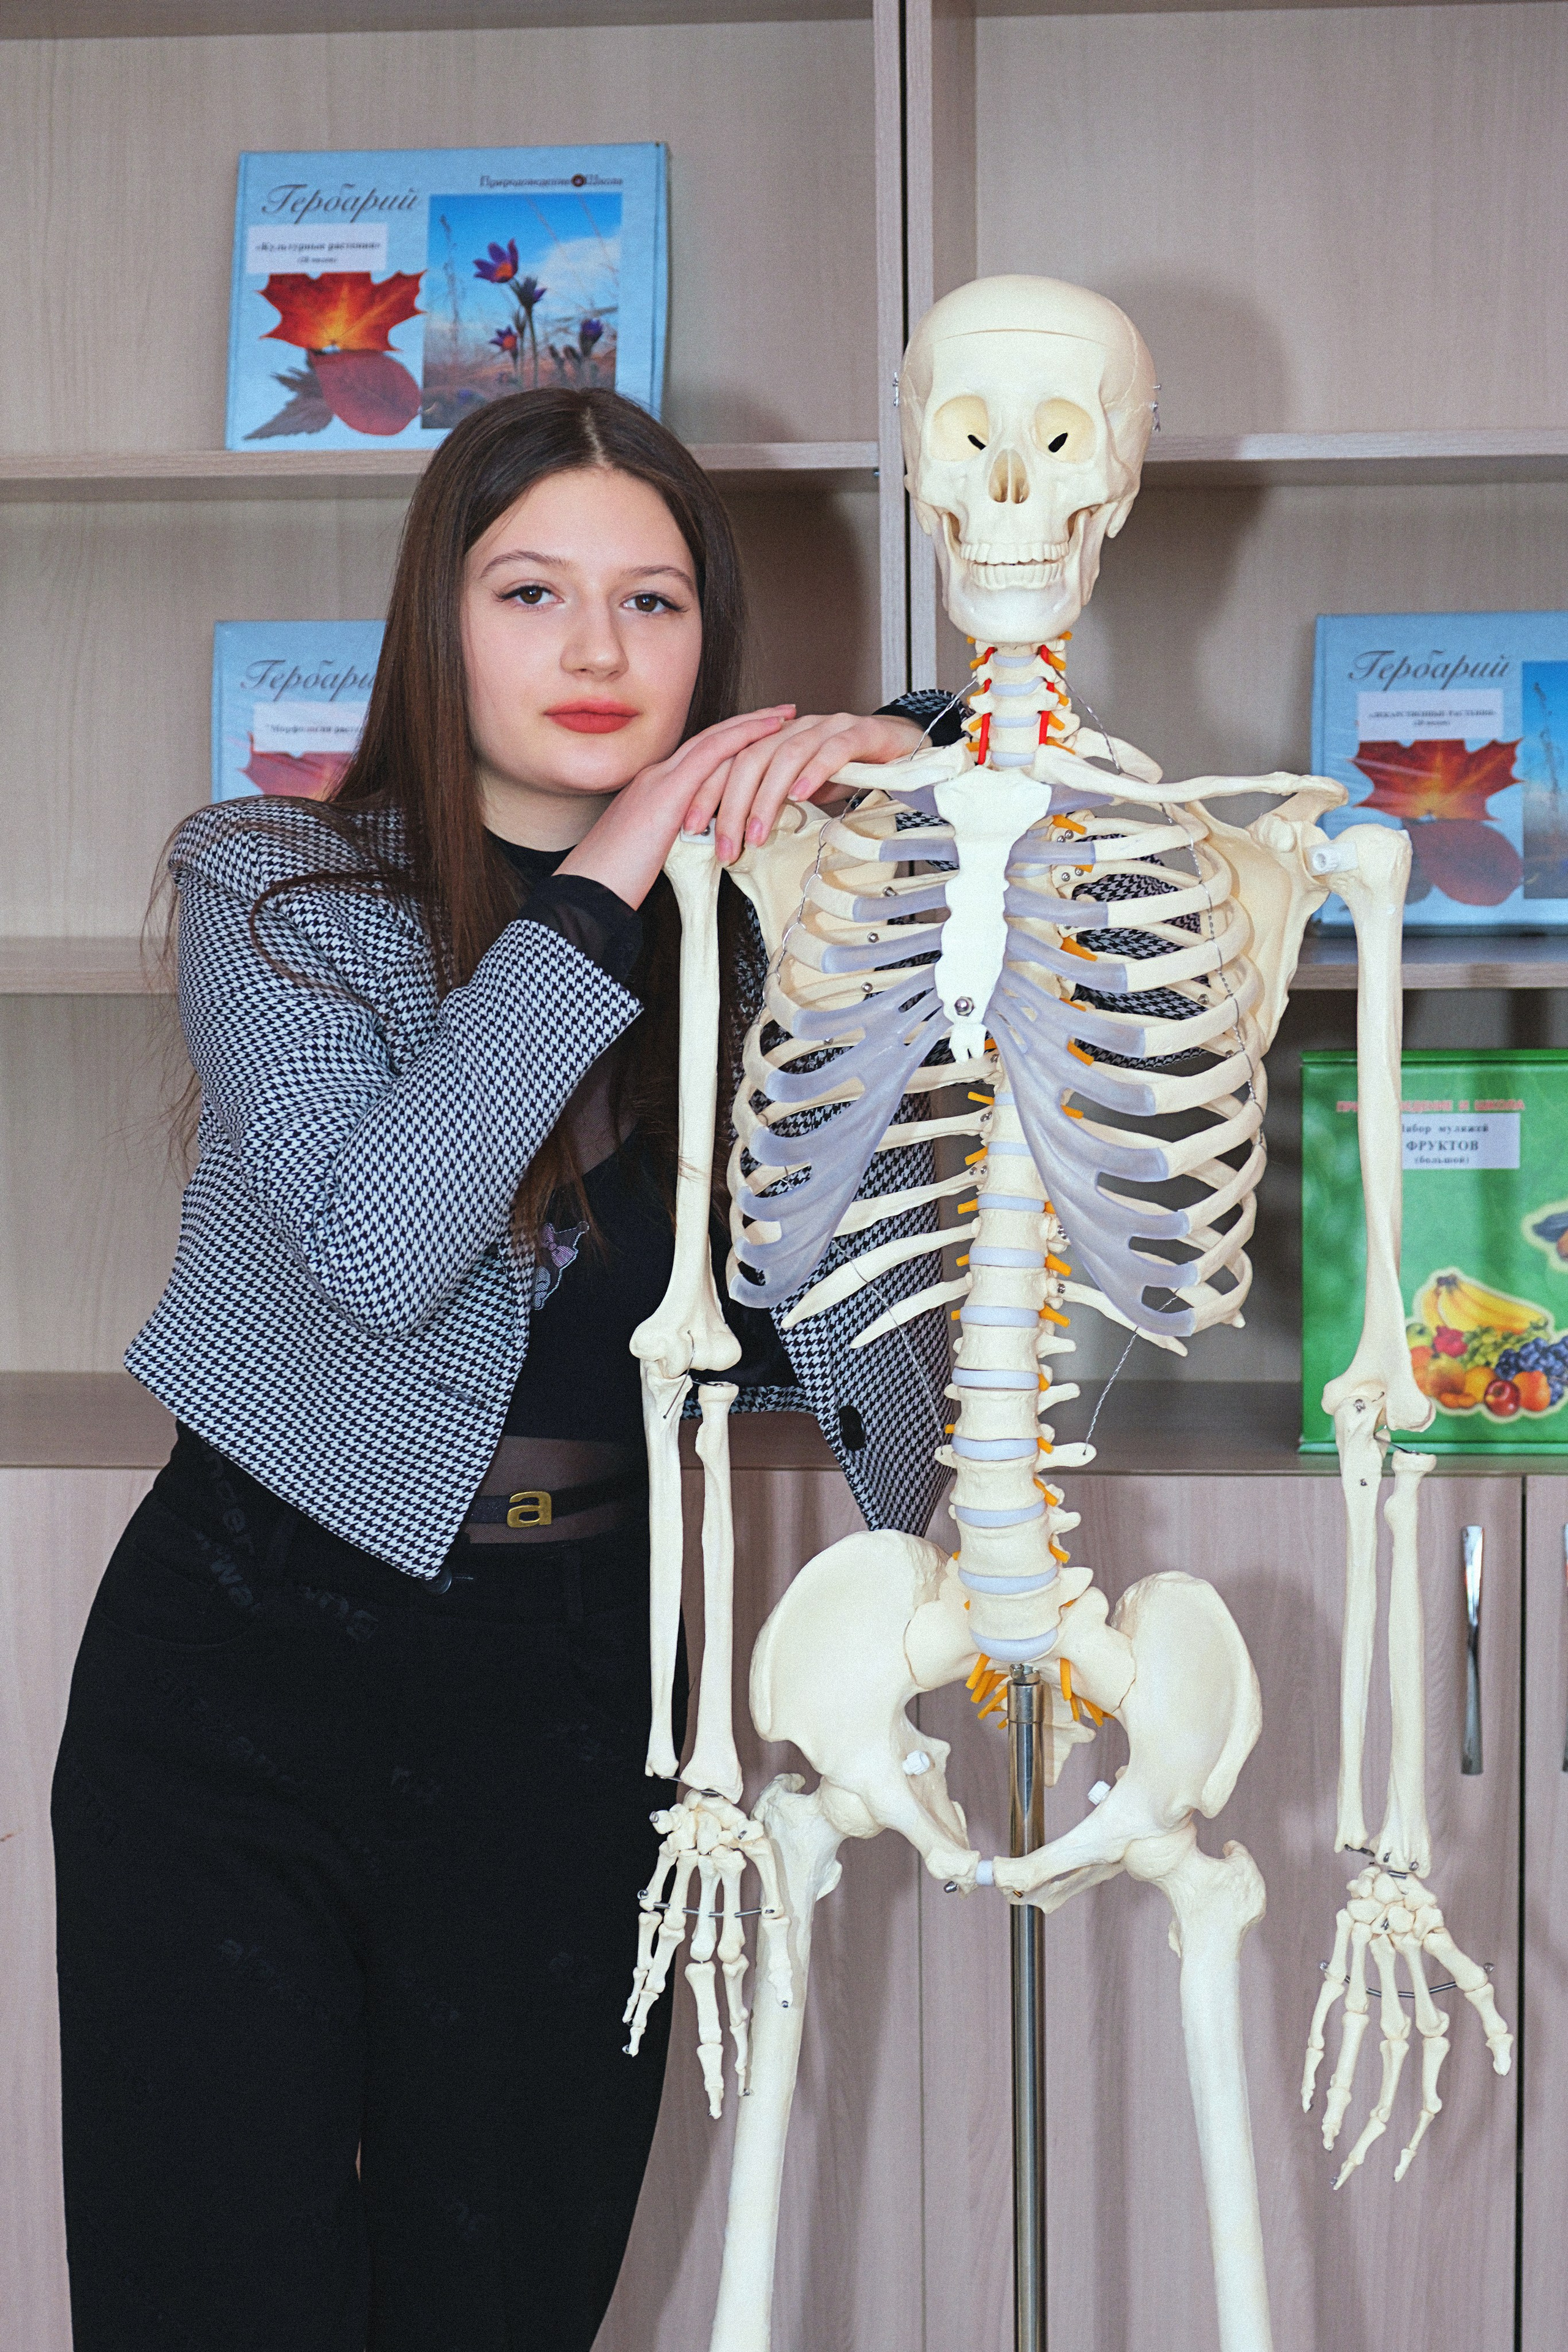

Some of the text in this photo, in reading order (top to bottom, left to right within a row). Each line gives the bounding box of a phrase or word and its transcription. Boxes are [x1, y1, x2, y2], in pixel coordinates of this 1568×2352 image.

[262, 183, 418, 225] Гербарий
[239, 660, 378, 702] Гербари
[1349, 650, 1510, 692] Гербарий
[1458, 1100, 1469, 1111] И
[1474, 1099, 1525, 1111] ШКОЛА
[1405, 1139, 1479, 1152] ФРУКТОВ
